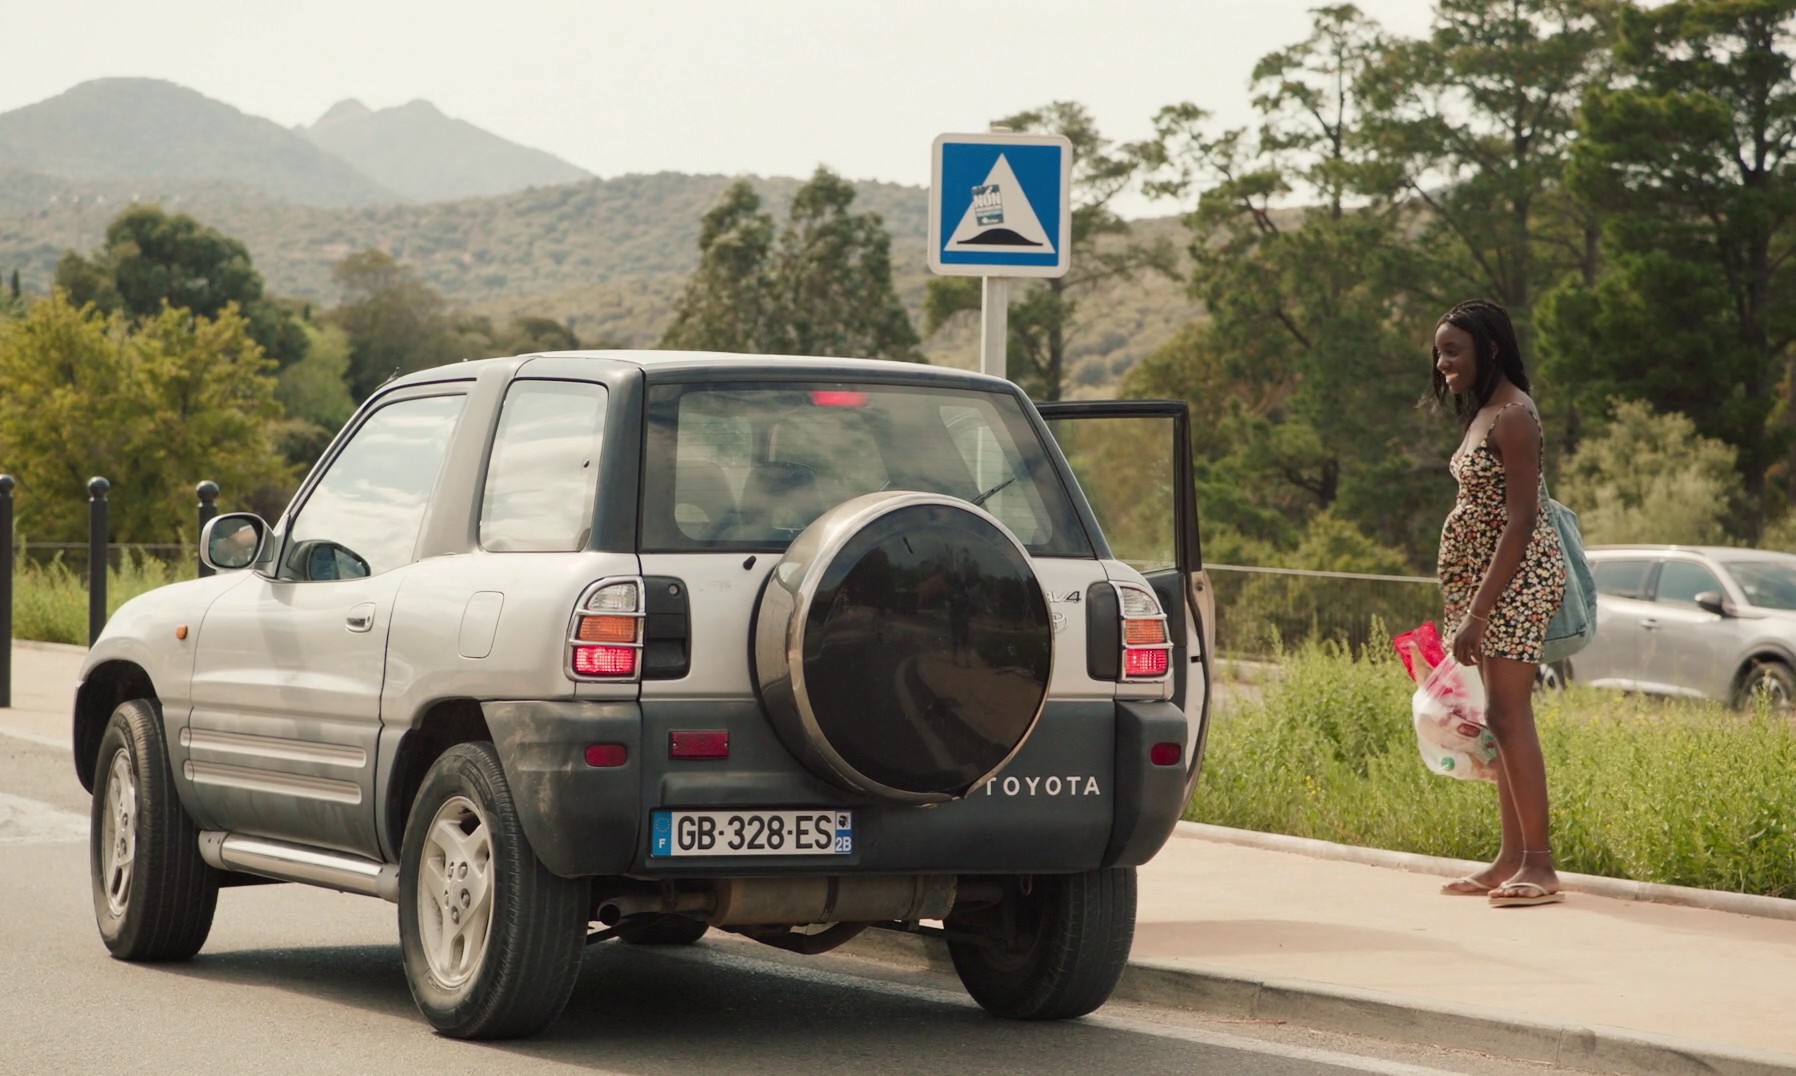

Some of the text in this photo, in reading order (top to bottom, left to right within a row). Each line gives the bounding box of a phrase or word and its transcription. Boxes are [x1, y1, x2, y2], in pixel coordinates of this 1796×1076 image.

[677, 815, 832, 850] GB-328-ES
[658, 838, 667, 849] F
[835, 836, 852, 851] 2B
